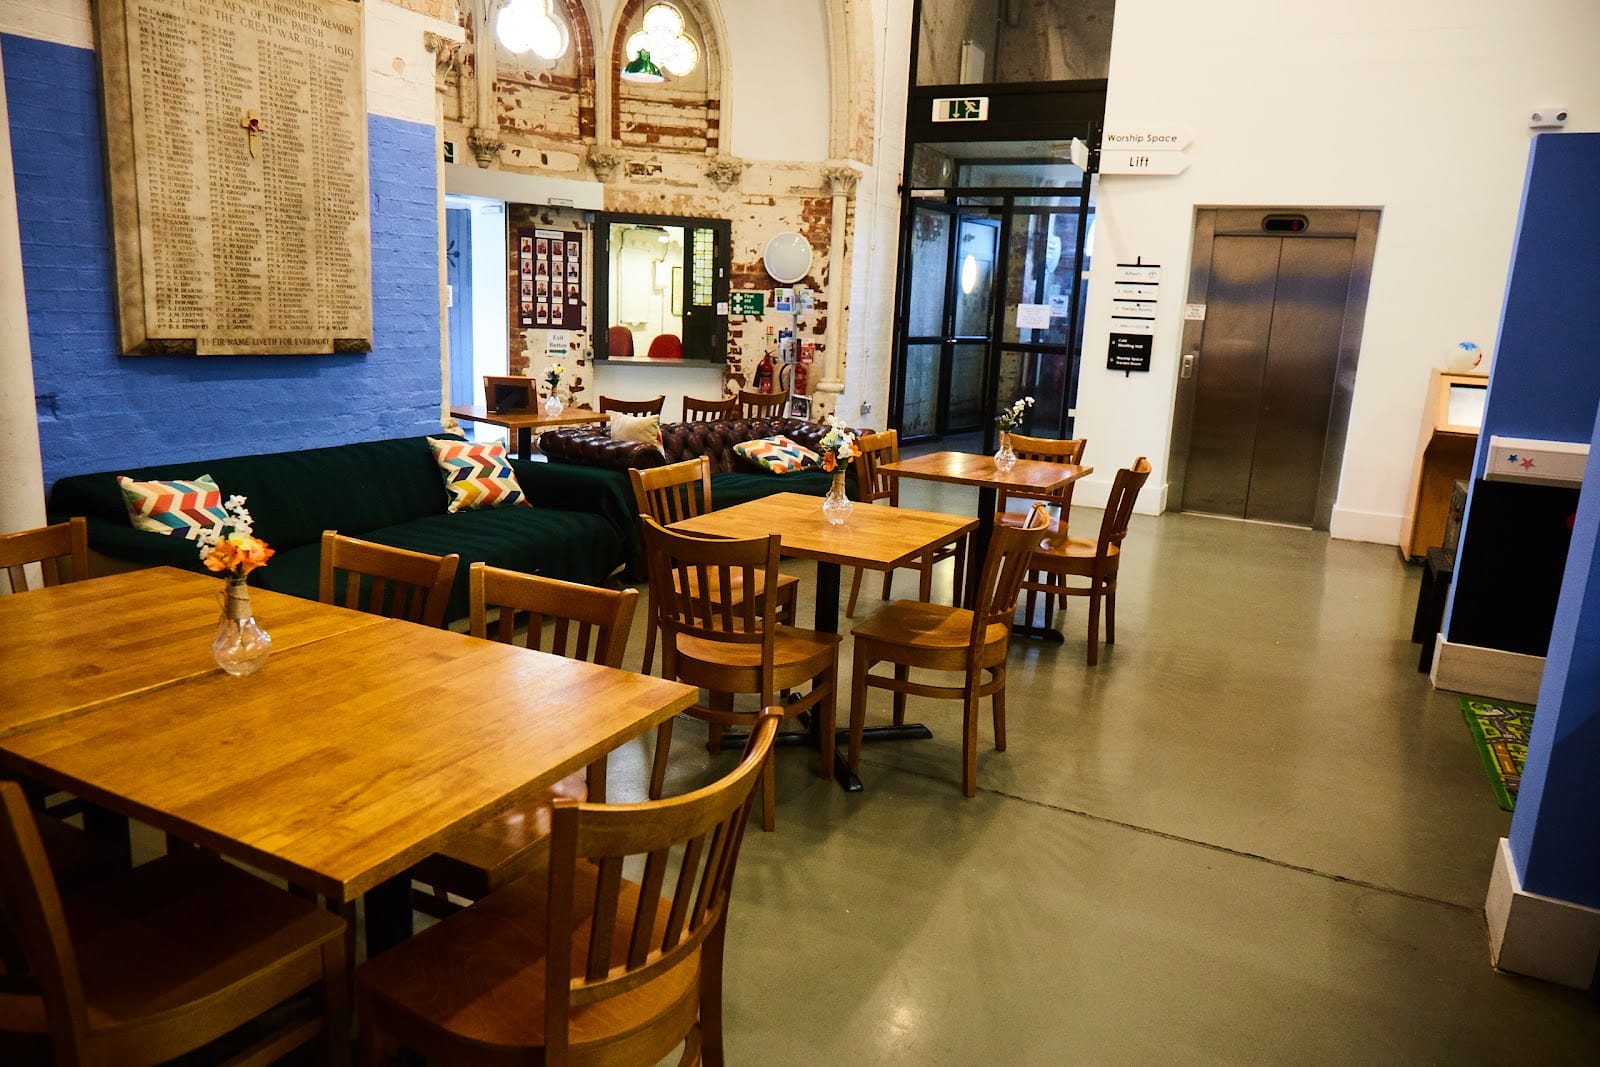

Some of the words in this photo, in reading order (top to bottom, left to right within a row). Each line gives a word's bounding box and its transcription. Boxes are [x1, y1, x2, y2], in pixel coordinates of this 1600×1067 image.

[223, 0, 245, 14] MEN
[250, 9, 262, 20] OF
[268, 13, 287, 26] THIS
[291, 21, 324, 38] PARISH
[320, 18, 353, 35] MEMORY
[199, 5, 210, 16] IN
[214, 10, 235, 25] THE
[240, 17, 273, 35] GREAT
[277, 28, 300, 42] WAR
[303, 36, 325, 49] 1914
[333, 44, 355, 60] 1919
[1107, 134, 1144, 143] Worship
[1146, 134, 1177, 142] Space
[1129, 156, 1149, 167] Lift
